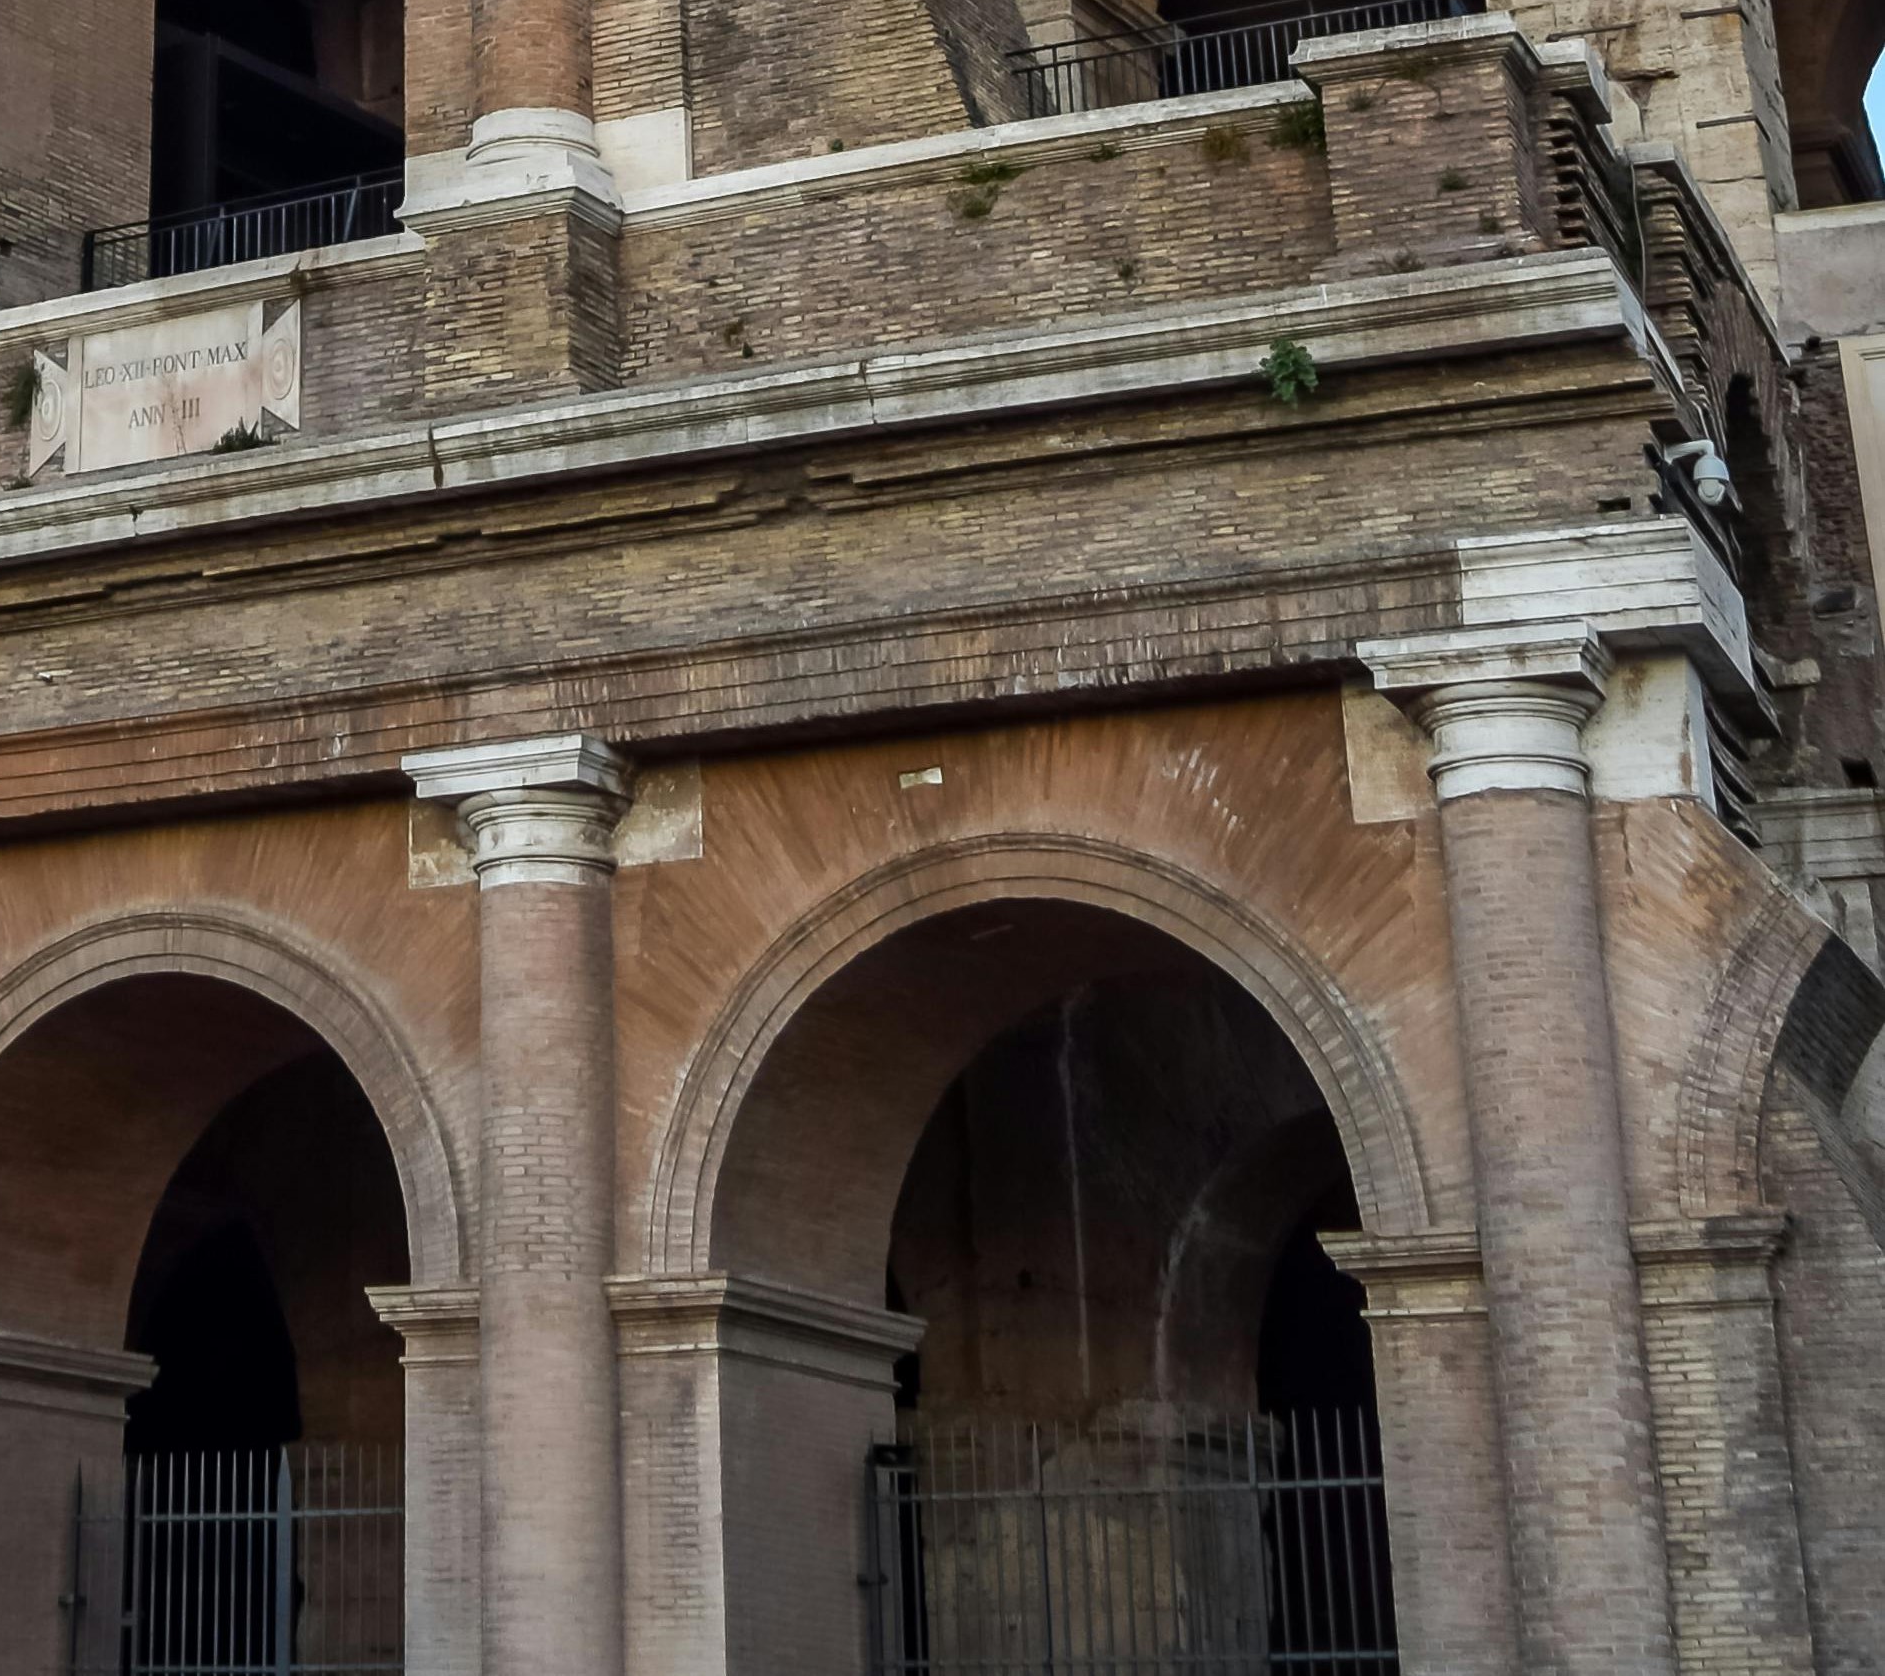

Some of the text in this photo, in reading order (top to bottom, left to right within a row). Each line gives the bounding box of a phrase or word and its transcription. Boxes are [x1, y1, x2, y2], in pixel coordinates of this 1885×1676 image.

[84, 366, 115, 389] LEO
[207, 341, 247, 366] MAX
[128, 403, 166, 429] ANN
